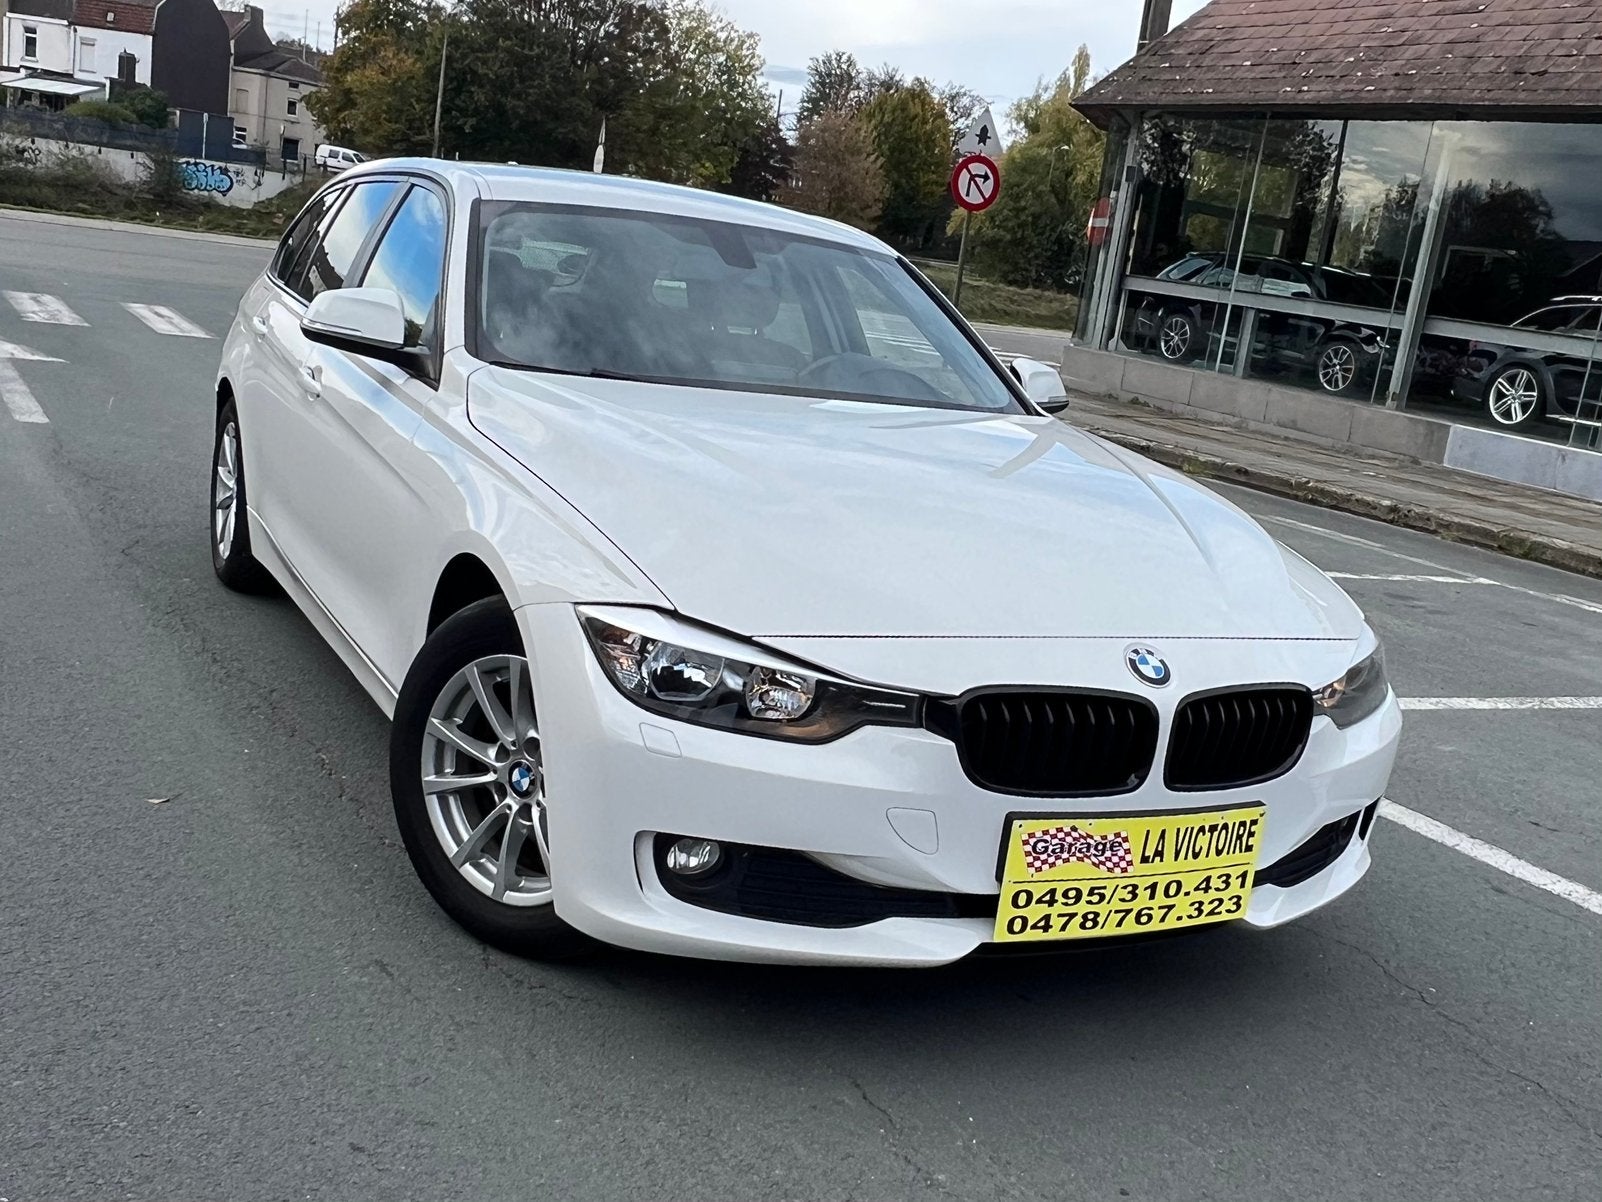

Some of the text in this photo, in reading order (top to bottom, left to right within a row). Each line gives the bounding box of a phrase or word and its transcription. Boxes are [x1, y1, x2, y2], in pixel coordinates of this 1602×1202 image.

[1031, 838, 1123, 857] Garage
[1140, 818, 1259, 864] LA VICTOIRE
[1010, 870, 1250, 910] 0495/310.431
[1006, 894, 1243, 936] 0478/767.323
